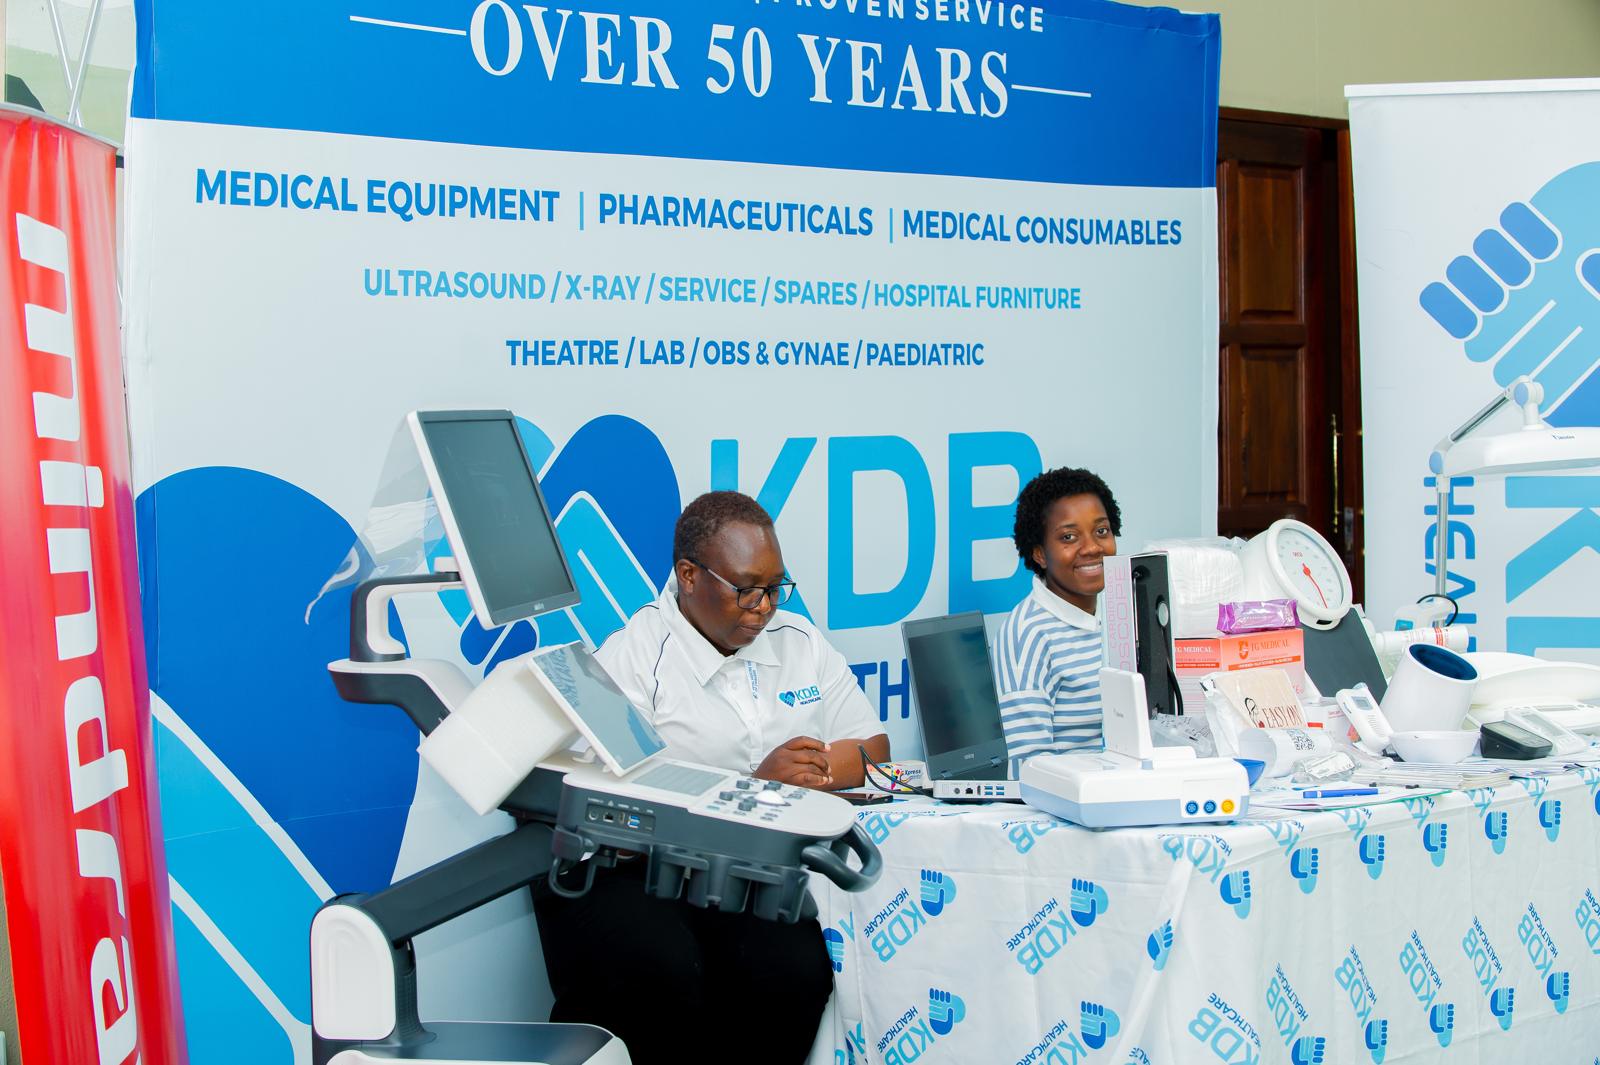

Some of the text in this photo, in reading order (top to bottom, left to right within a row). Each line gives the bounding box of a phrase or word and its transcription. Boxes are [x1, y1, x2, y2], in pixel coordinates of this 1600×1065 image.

[915, 0, 1044, 32] SERVICE
[470, 0, 1009, 119] OVER 50 YEARS
[196, 168, 560, 222] MEDICAL EQUIPMENT
[600, 193, 873, 236] PHARMACEUTICALS
[903, 209, 1182, 246] MEDICAL CONSUMABLES
[363, 268, 546, 299] ULTRASOUND
[565, 274, 641, 301] X-RAY
[659, 276, 756, 303] SERVICE
[774, 280, 858, 306] SPARES
[874, 283, 971, 308] HOSPITAL
[976, 286, 1081, 309] FURNITURE
[506, 340, 619, 366] THEATRE
[639, 340, 685, 365] LAB
[703, 340, 750, 366] OBS
[756, 341, 770, 365] &
[774, 341, 850, 366] GYNAE
[866, 343, 985, 366] PAEDIATRIC
[711, 431, 1043, 630] KDB
[15, 211, 142, 1065] mindra
[1261, 638, 1291, 650] MEDICAL
[794, 685, 820, 701] KDB
[863, 887, 910, 938] HEALTHCARE
[871, 899, 928, 964] KDB
[1006, 897, 1059, 952] HEALTHCARE
[1016, 910, 1077, 976] KDB
[1462, 927, 1498, 996] KDB
[1517, 913, 1554, 980] KDB
[1334, 956, 1373, 1028] KDB
[1399, 941, 1437, 1013] KDB
[1266, 977, 1300, 1047] KDB
